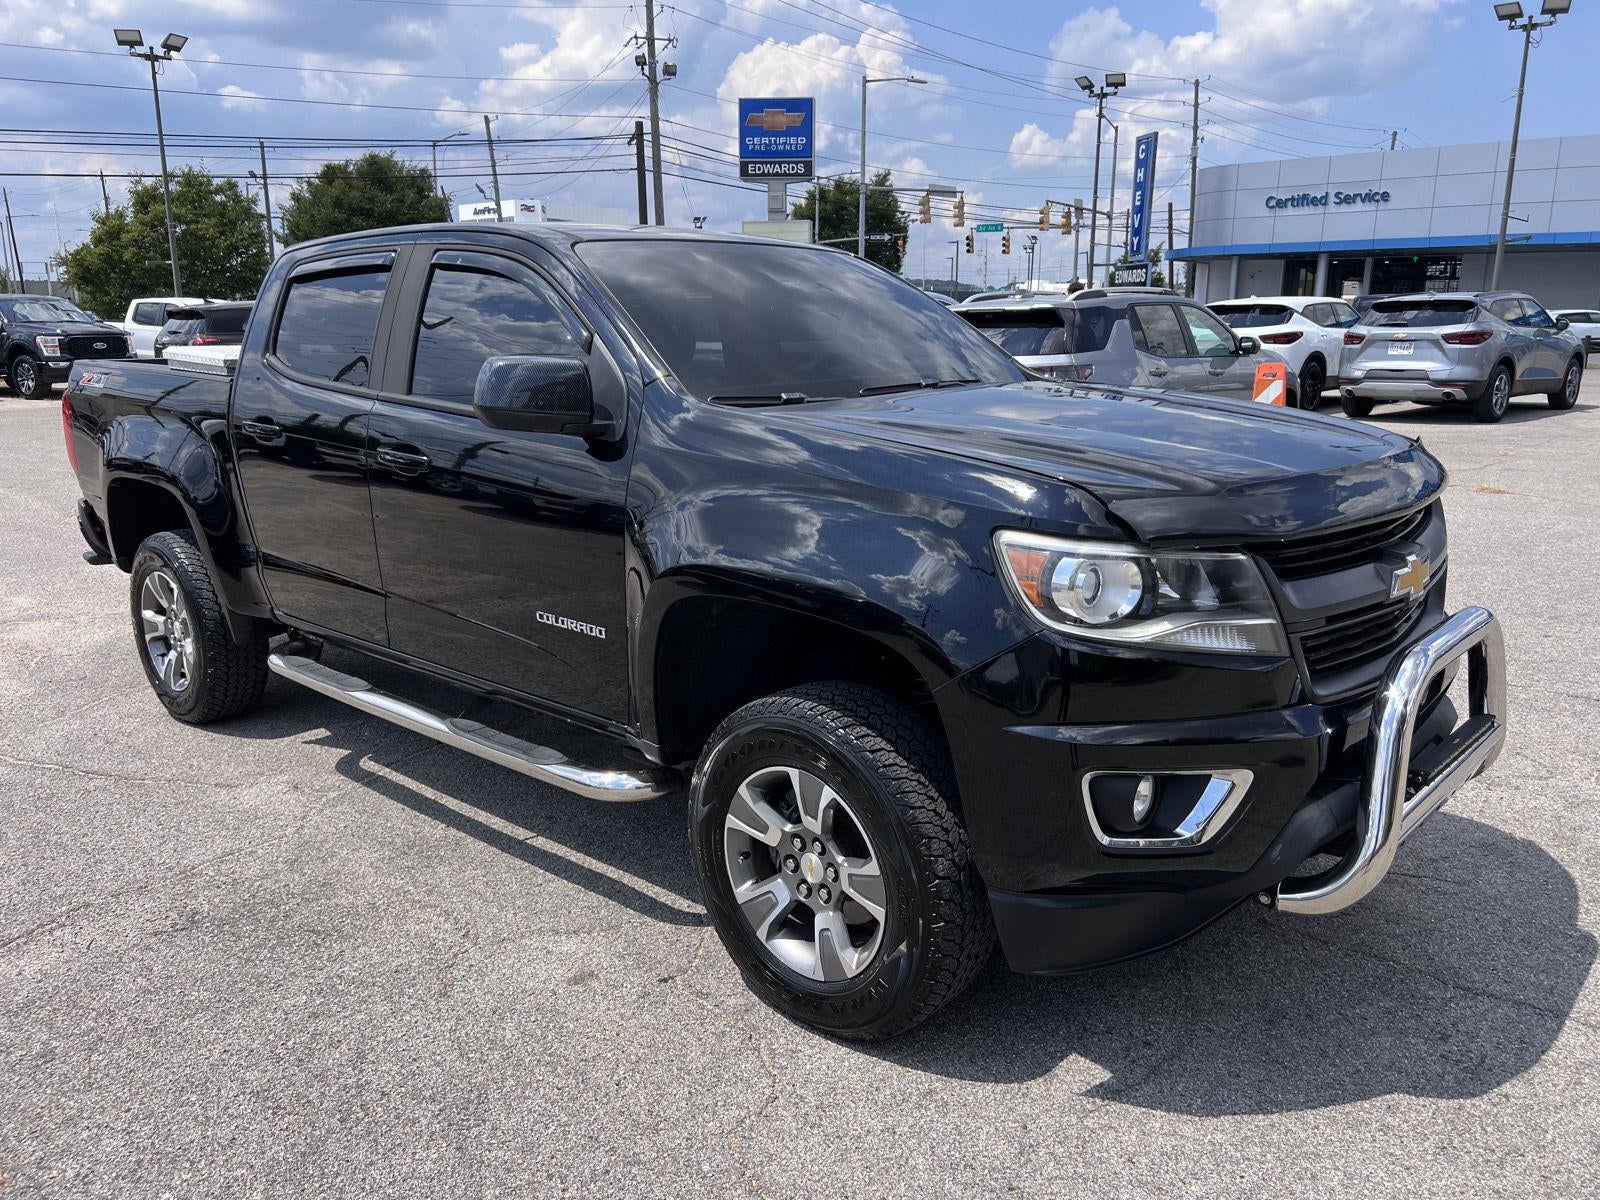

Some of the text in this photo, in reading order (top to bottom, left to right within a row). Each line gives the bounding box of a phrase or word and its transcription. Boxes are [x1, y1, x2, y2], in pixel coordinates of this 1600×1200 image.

[745, 136, 807, 145] CERTIFIED
[748, 163, 805, 174] EDWARDS
[1132, 143, 1146, 252] CHEVY
[1265, 188, 1391, 209] Certified Service
[473, 206, 498, 216] AmFirs
[1114, 268, 1147, 284] EDWARDS
[79, 372, 108, 388] Z71
[535, 610, 606, 639] COLORADO
